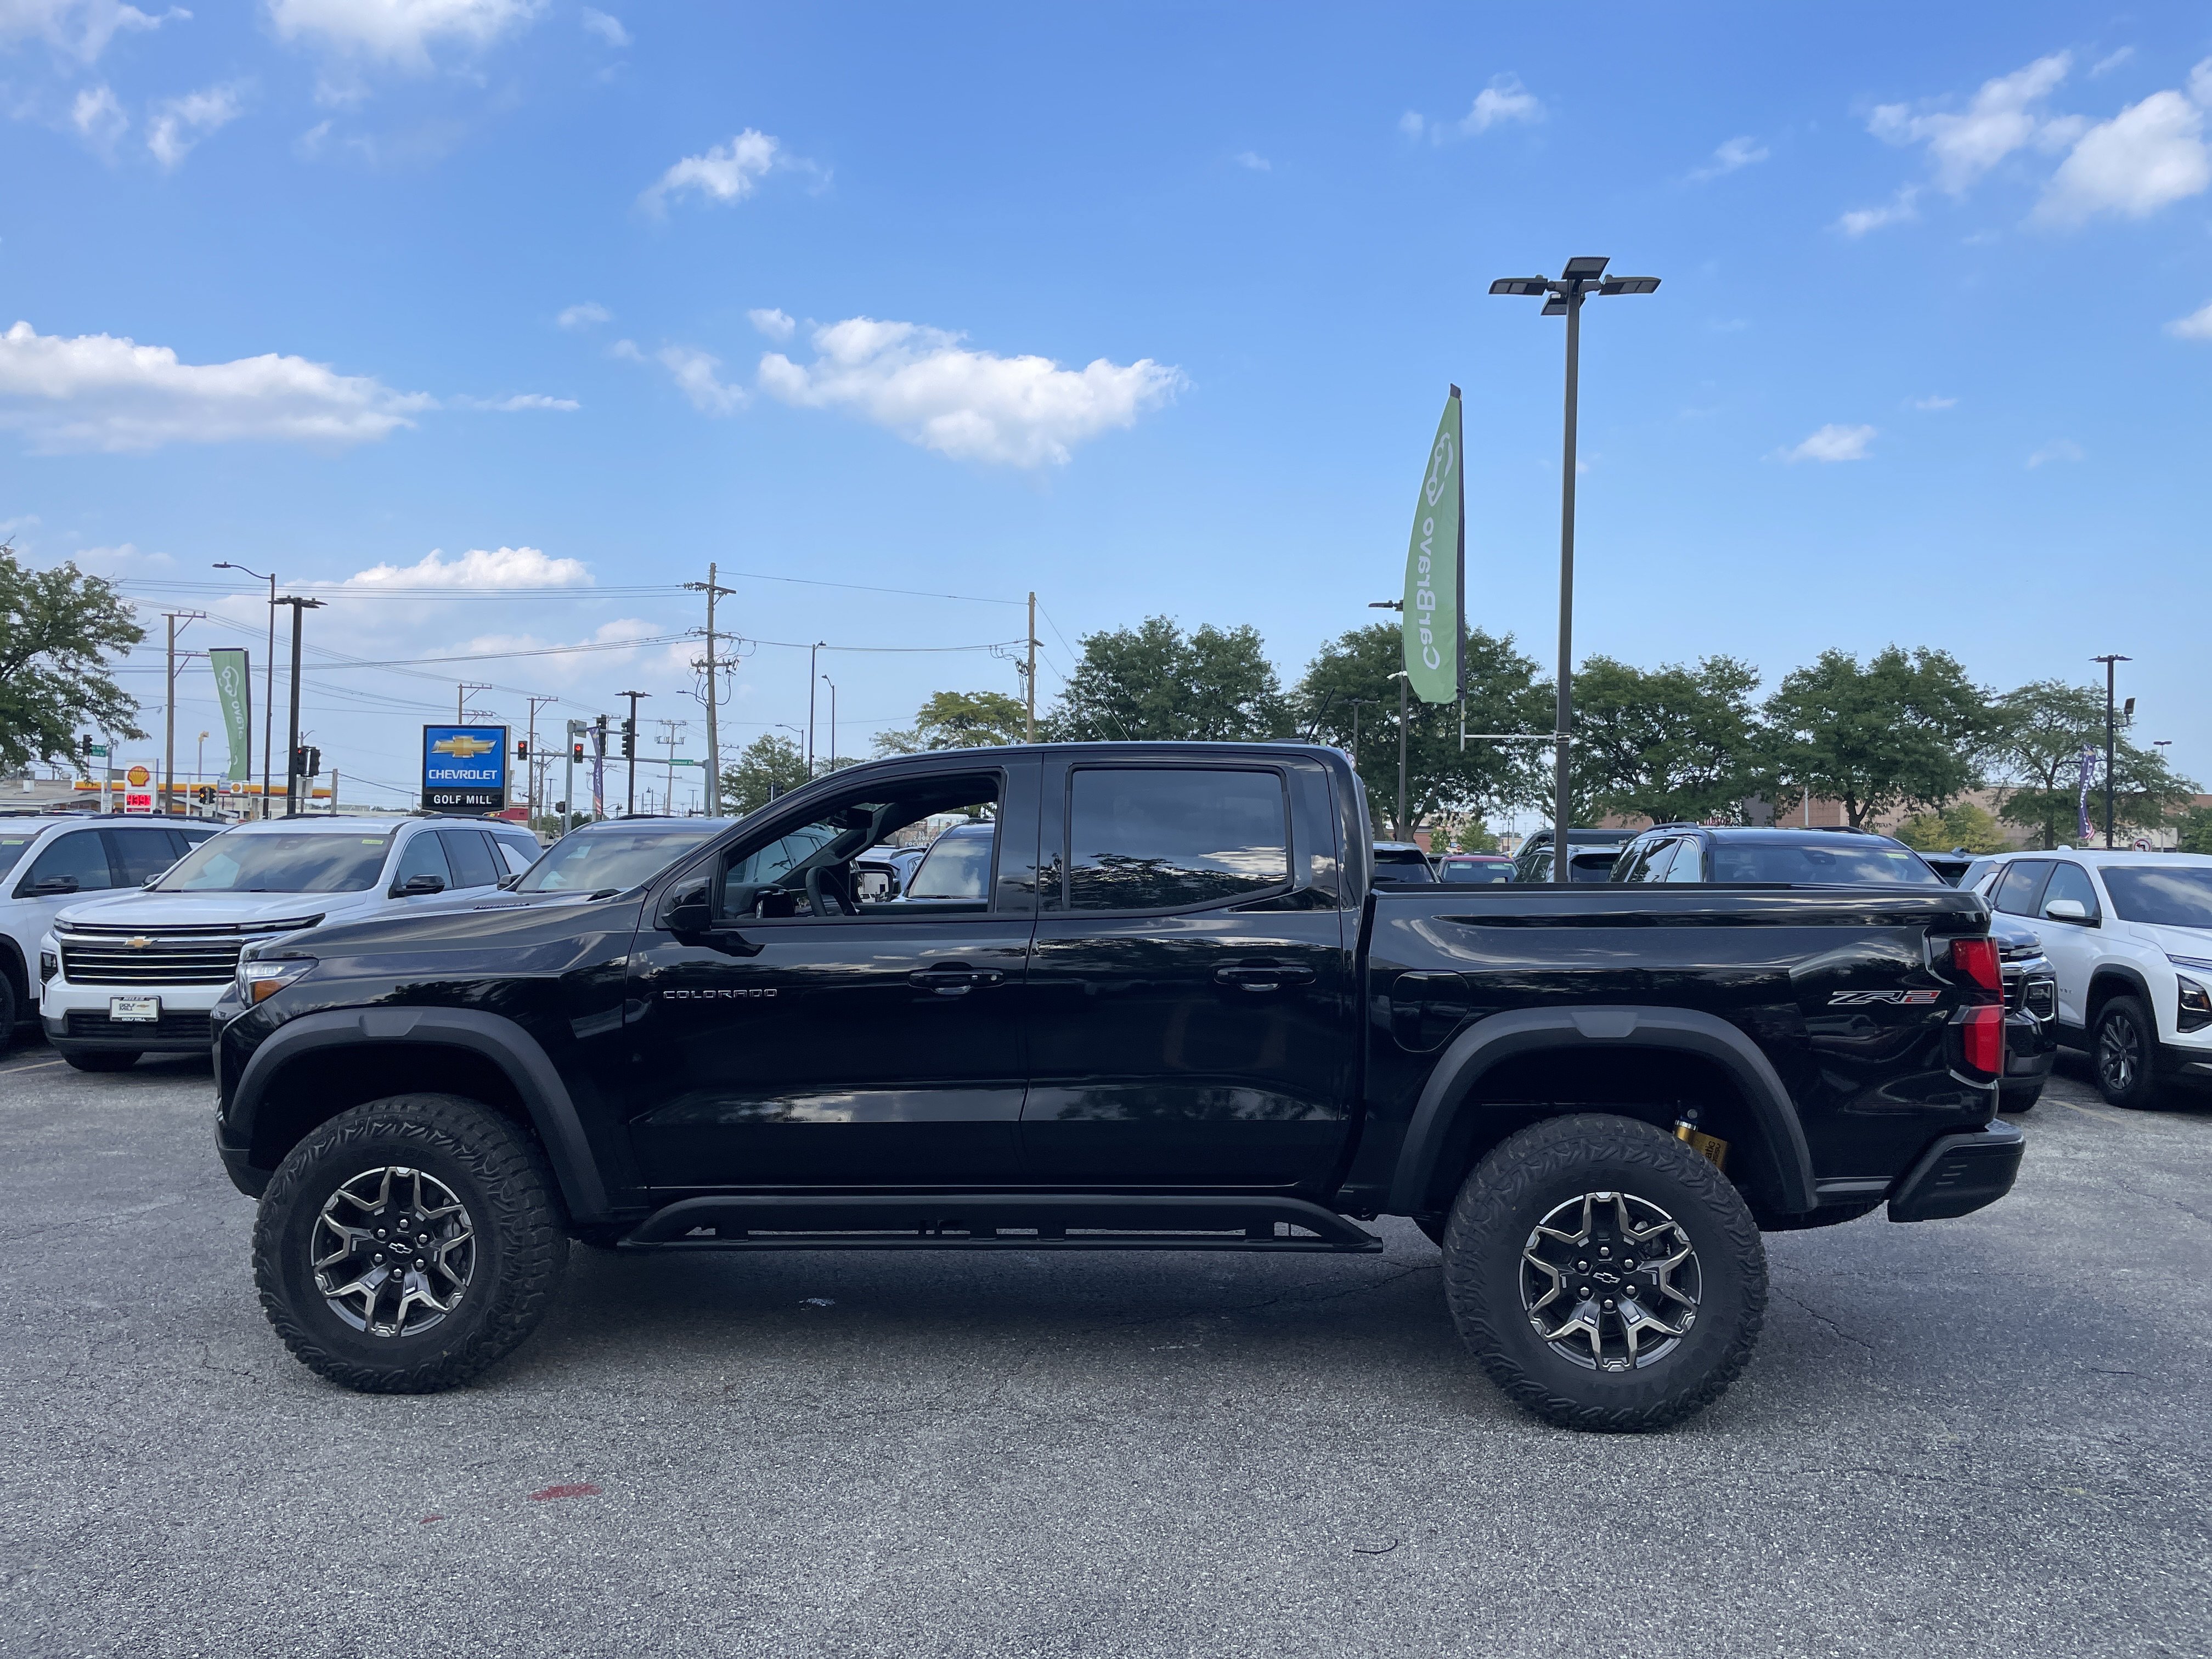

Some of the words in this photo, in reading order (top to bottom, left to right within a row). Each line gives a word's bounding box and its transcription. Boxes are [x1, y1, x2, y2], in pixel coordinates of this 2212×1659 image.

[428, 769, 498, 780] CHEVROLET
[433, 794, 461, 804] GOLF
[466, 795, 492, 804] MILL
[663, 989, 777, 998] COLORADO
[1827, 990, 1942, 1005] ZR2
[1705, 1141, 1716, 1159] atic
